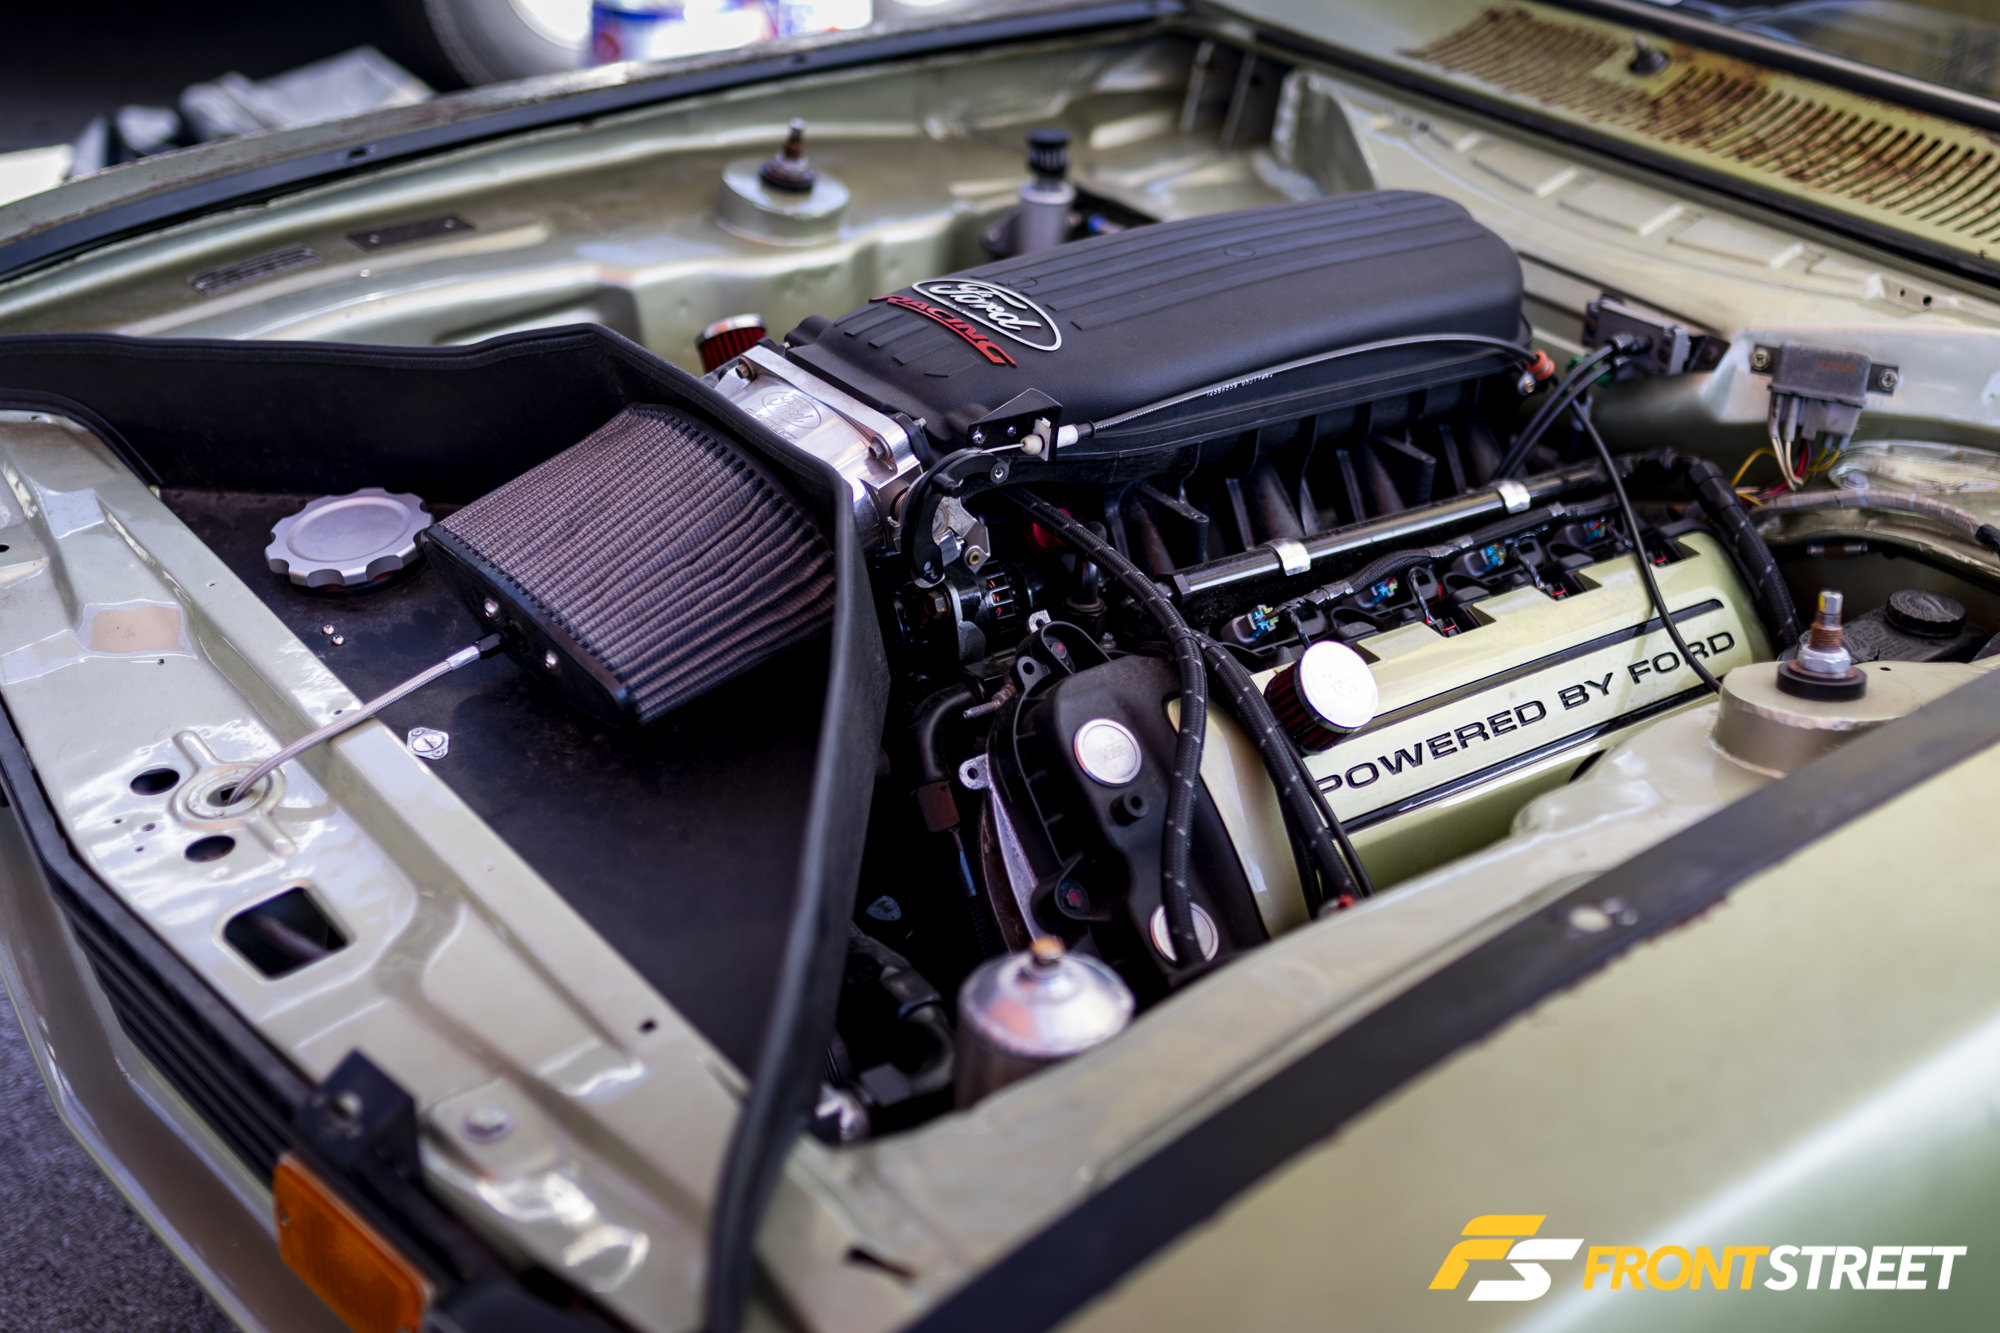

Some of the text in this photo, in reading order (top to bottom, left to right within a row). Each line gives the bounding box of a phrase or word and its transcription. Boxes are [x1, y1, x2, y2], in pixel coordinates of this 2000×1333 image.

[870, 294, 1017, 366] RACING
[928, 283, 1042, 331] Ford
[1315, 631, 1735, 795] POWERED BY FORD
